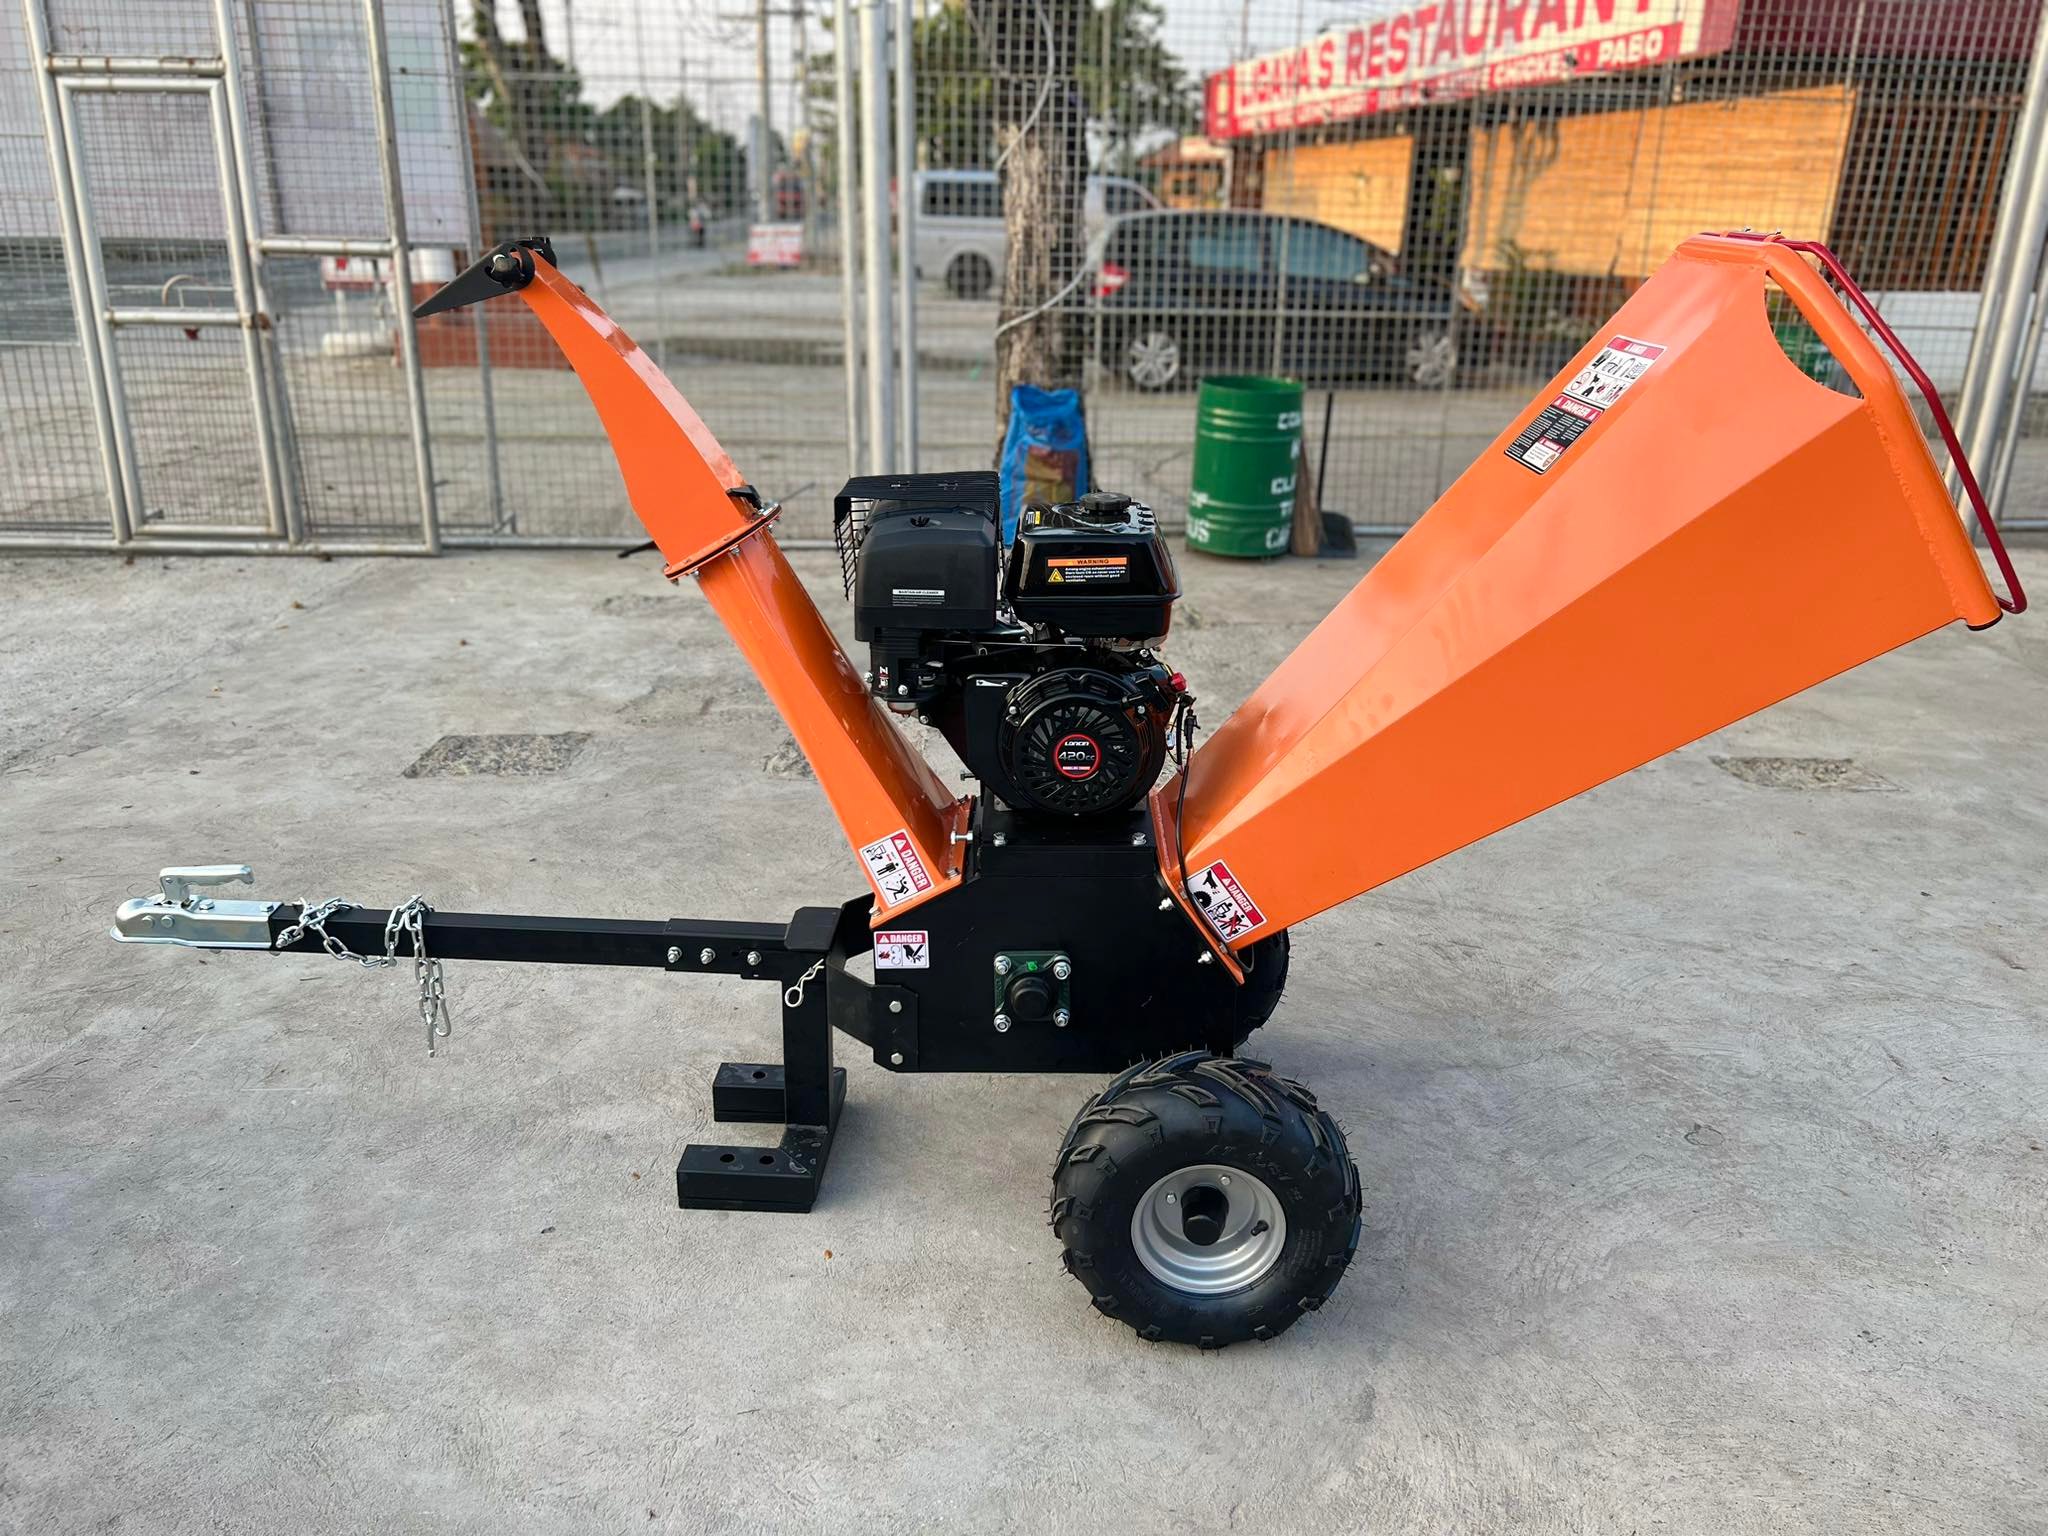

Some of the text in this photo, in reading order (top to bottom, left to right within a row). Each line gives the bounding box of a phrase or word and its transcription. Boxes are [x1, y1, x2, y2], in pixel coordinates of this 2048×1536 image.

[1345, 0, 1650, 87] RESTAURA
[1599, 30, 1664, 66] PABO
[1058, 751, 1096, 761] 420cc
[900, 848, 929, 889] DANGER
[1227, 884, 1254, 913] DANGER
[889, 934, 923, 944] DANGER
